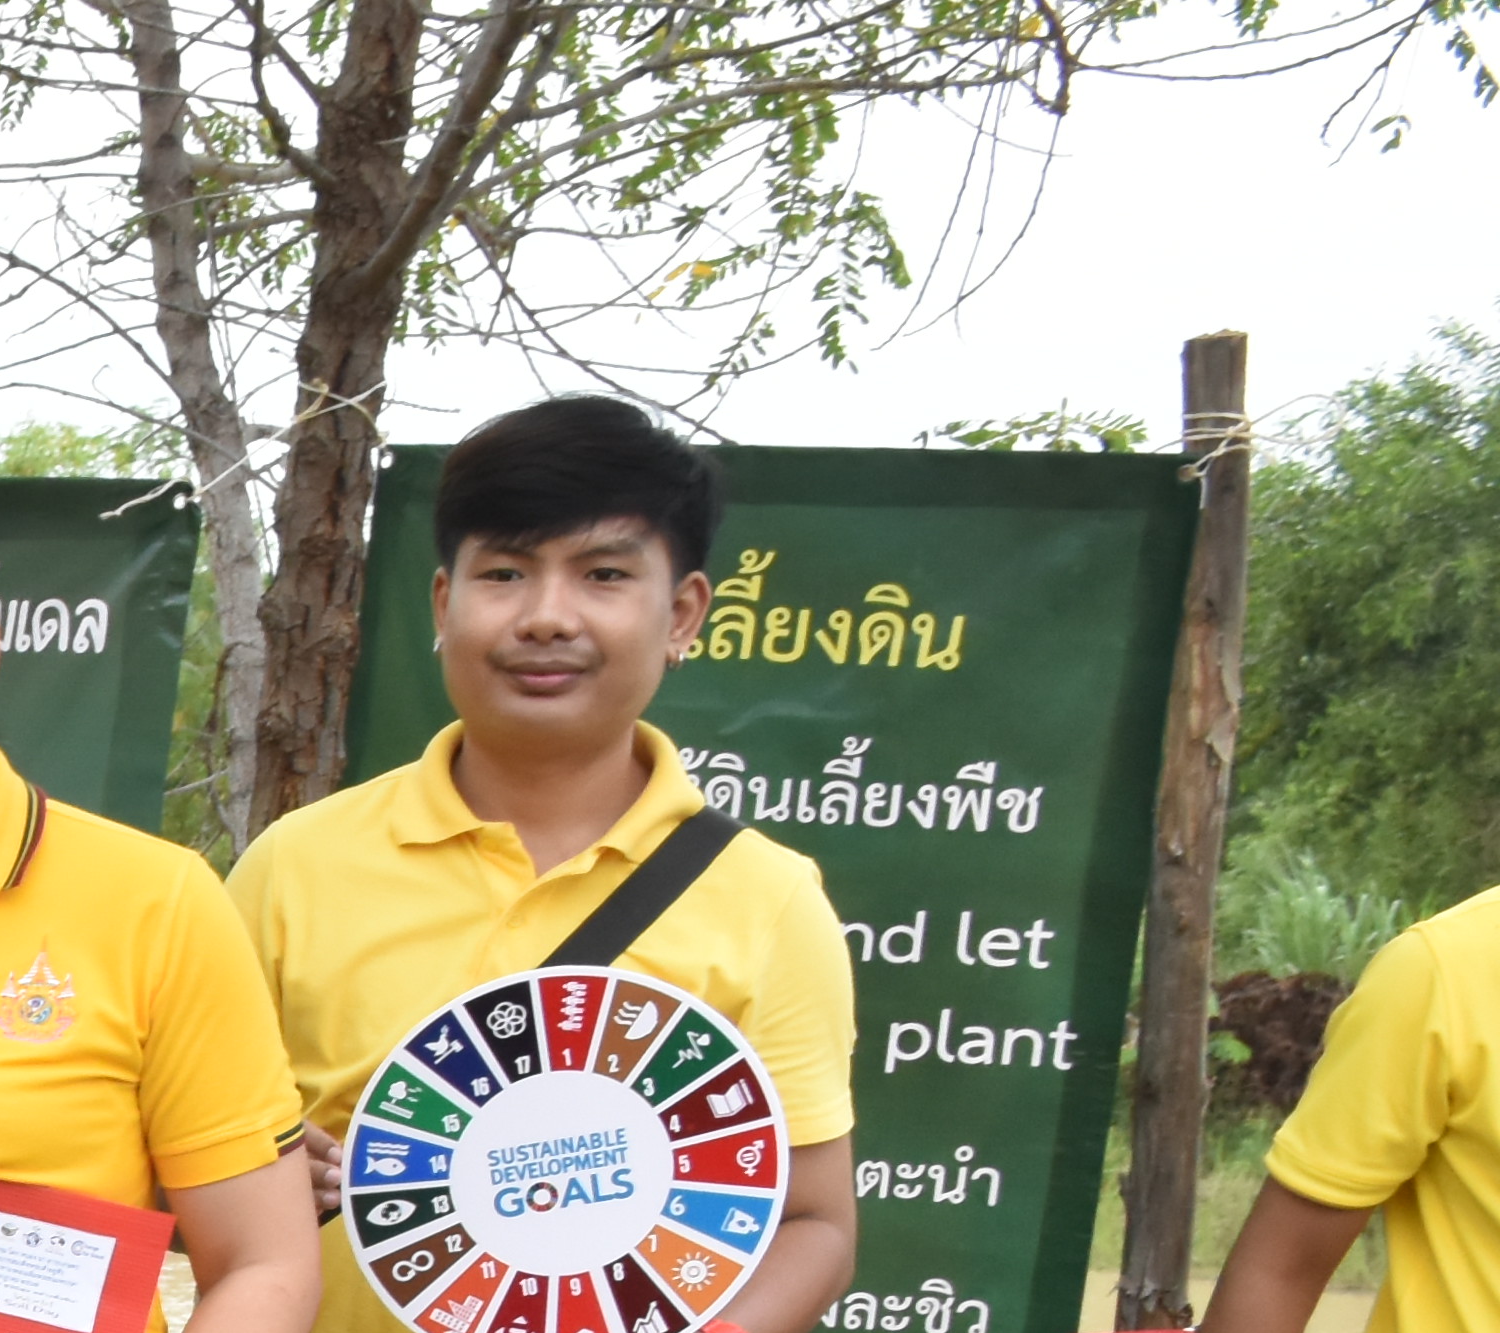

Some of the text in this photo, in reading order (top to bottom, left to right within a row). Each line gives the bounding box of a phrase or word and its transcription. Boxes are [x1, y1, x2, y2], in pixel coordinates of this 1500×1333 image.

[956, 910, 1055, 969] let
[884, 1008, 1079, 1073] plant
[514, 1055, 532, 1074] 17
[562, 1049, 572, 1067] 1
[607, 1055, 619, 1073] 2
[471, 1077, 492, 1097] 16
[643, 1078, 655, 1096] 3
[441, 1113, 462, 1133] 15
[669, 1114, 681, 1133] 4
[486, 1128, 629, 1167] SUSTAINABLE
[428, 1154, 448, 1173] 14
[490, 1147, 629, 1186] DEVELOPMENT
[678, 1155, 691, 1173] 5
[493, 1168, 635, 1218] GOALS
[430, 1195, 450, 1215] 13
[669, 1196, 686, 1216] 6
[445, 1234, 463, 1253] 12
[648, 1234, 659, 1253] 7
[480, 1261, 497, 1279] 11
[613, 1263, 624, 1281] 8
[519, 1277, 539, 1296] 10
[569, 1278, 582, 1297] 9
